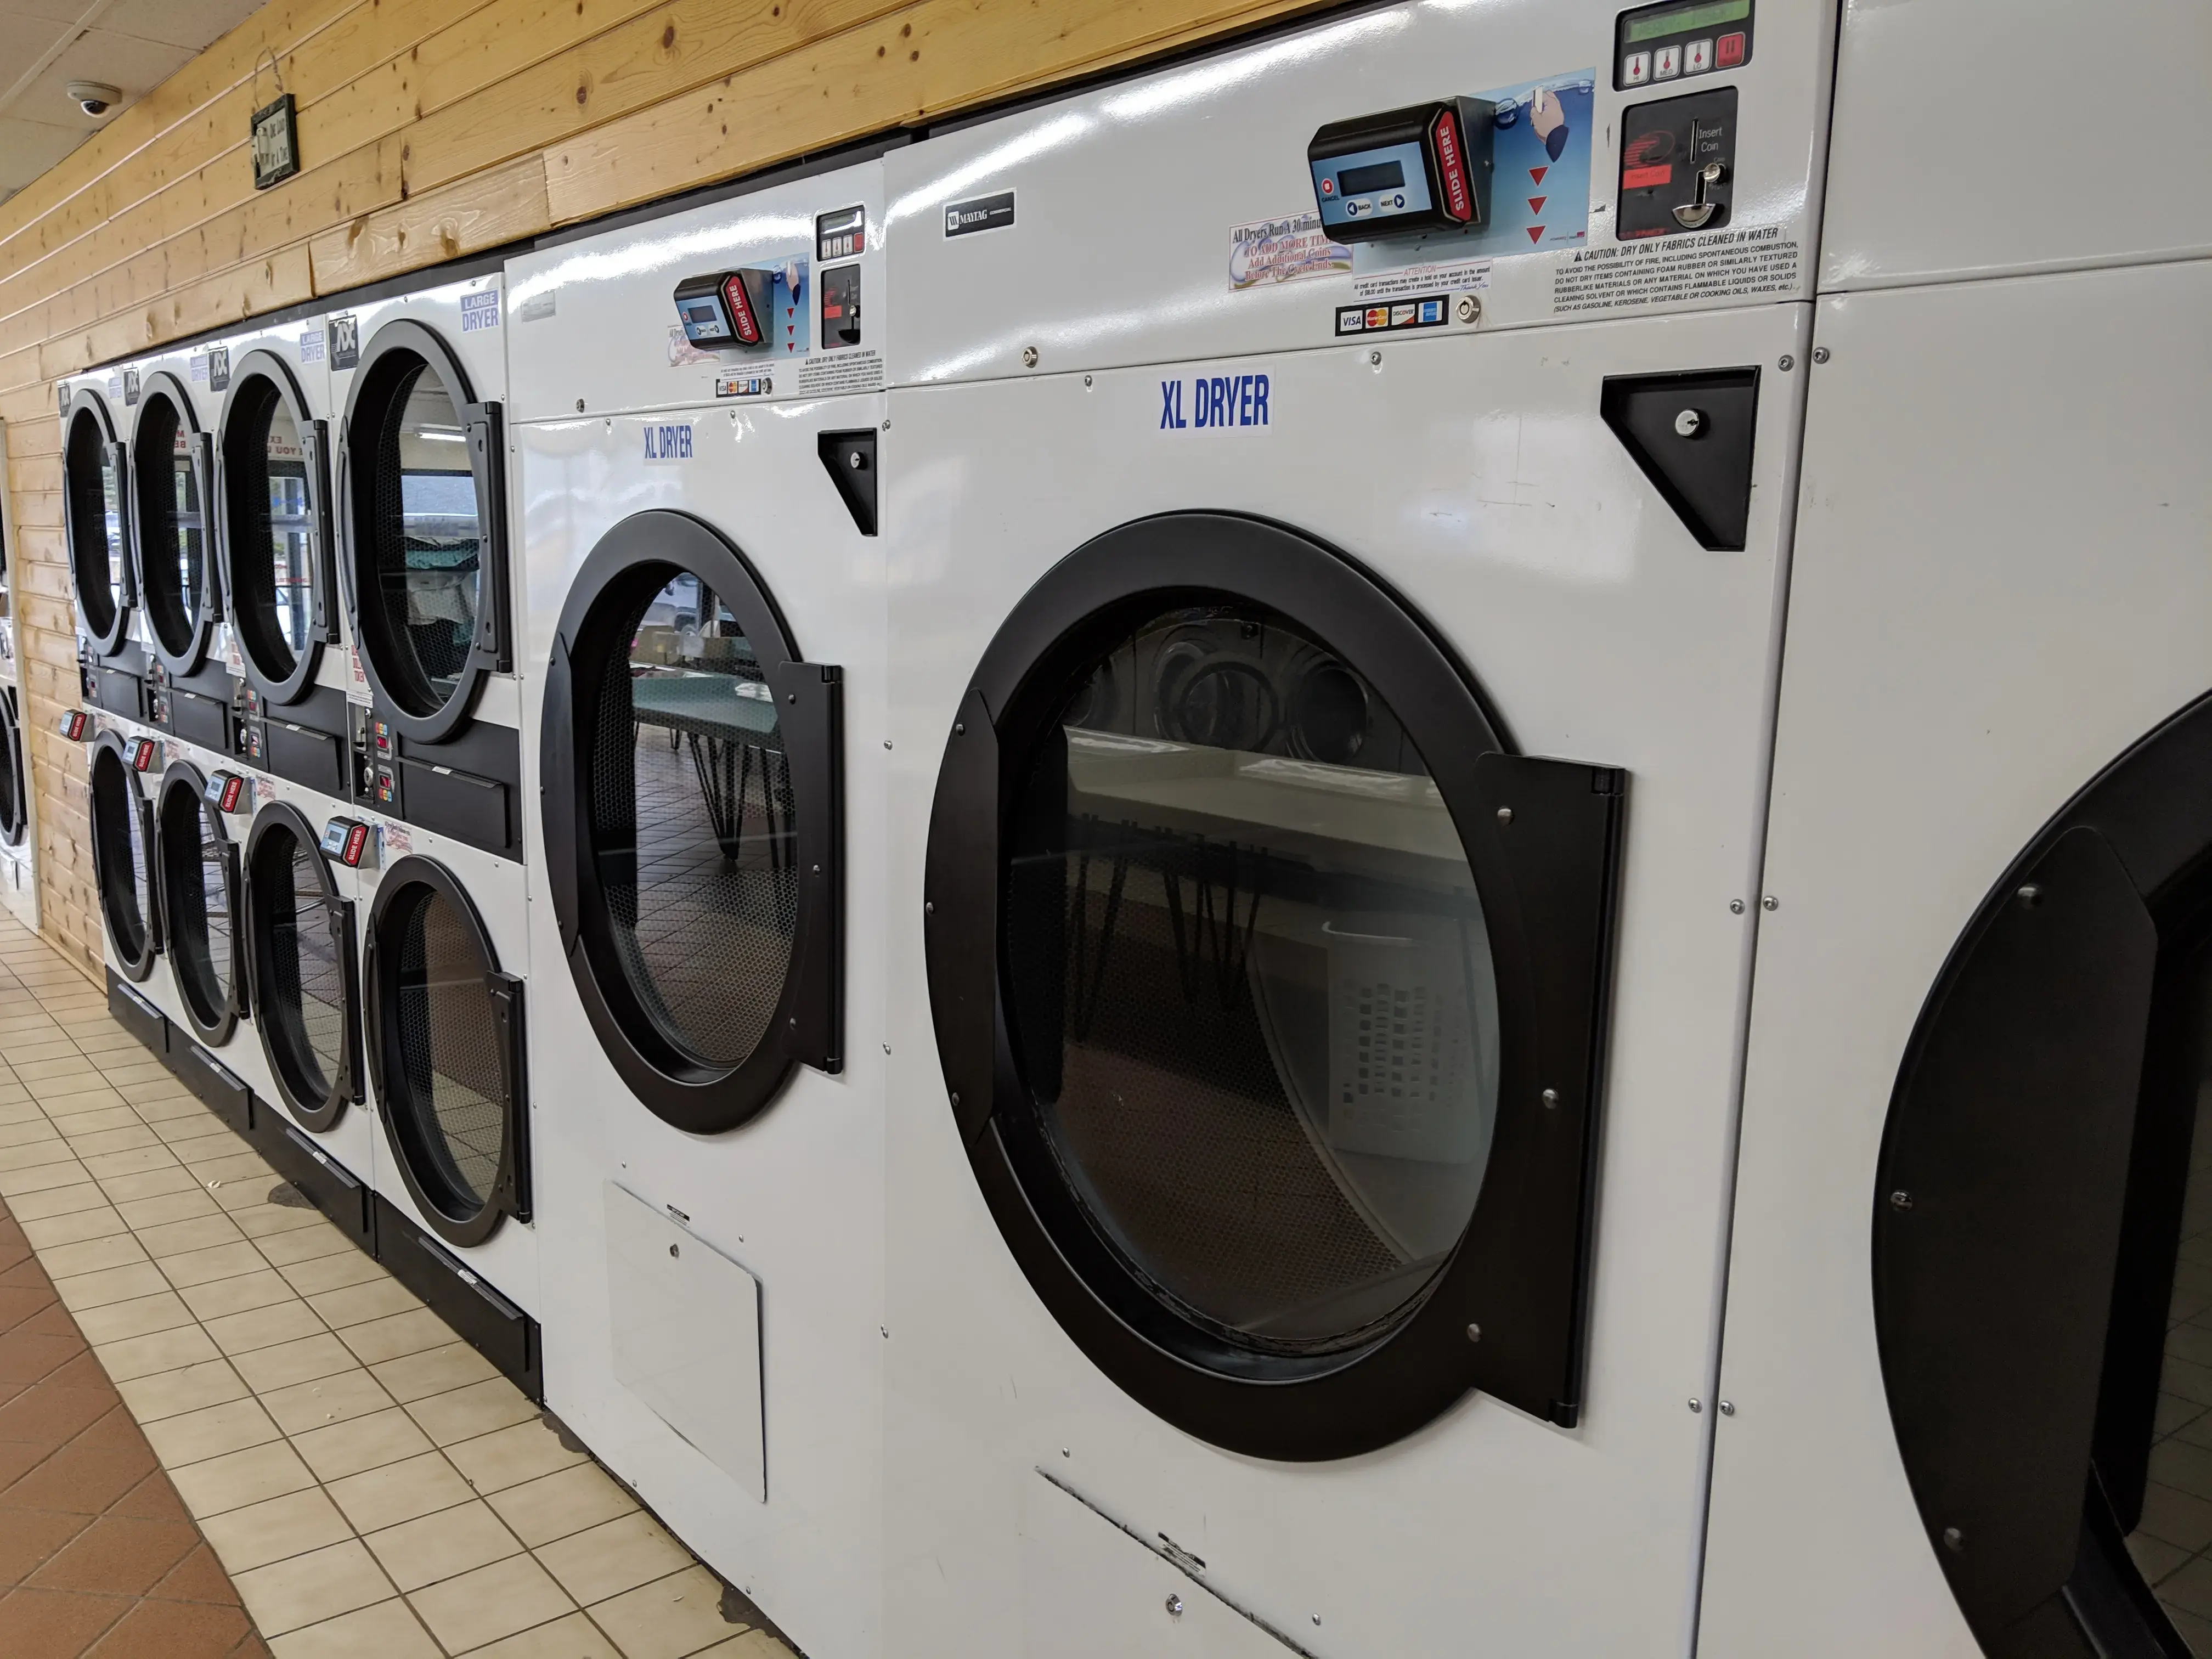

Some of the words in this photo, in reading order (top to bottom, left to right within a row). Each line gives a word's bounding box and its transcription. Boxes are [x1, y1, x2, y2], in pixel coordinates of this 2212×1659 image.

[1699, 126, 1723, 139] Insert
[1440, 126, 1455, 167] HERE
[1701, 142, 1719, 153] Coin
[1449, 168, 1464, 211] SLIDE
[959, 209, 988, 224] MAYTAG
[1233, 227, 1243, 243] All
[1244, 226, 1268, 244] Dryers
[1269, 223, 1283, 236] Run
[1284, 221, 1291, 234] A
[1293, 218, 1301, 233] 30
[1244, 246, 1257, 258] TO
[1258, 242, 1278, 255] ADD
[1280, 238, 1308, 252] MORE
[1584, 248, 1619, 261] CAUTION:
[1621, 245, 1638, 257] DRY
[1639, 242, 1661, 255] ONLY
[1661, 237, 1696, 251] FABRICS
[1697, 233, 1735, 247] CLEANED
[1736, 232, 1746, 242] IN
[1748, 228, 1778, 241] WATER
[1248, 257, 1264, 269] Add
[1266, 250, 1306, 265] Additional
[1308, 246, 1331, 258] Coins
[1565, 266, 1583, 274] AVOID
[1597, 261, 1634, 270] POSSIBILITY
[1662, 253, 1697, 263] INCLUDING
[1699, 247, 1749, 259] SPONTANEOUS
[1750, 241, 1798, 253] COMBUSTION,
[1594, 272, 1613, 280] ITEMS
[1615, 268, 1655, 278] CONTAINING
[1657, 265, 1675, 273] FOAM
[1677, 262, 1706, 270] RUBBER
[1720, 256, 1757, 267] SIMILARLY
[1760, 251, 1798, 262] TEXTURED
[1245, 269, 1270, 281] Before
[1272, 266, 1286, 277] The
[1404, 265, 1437, 276] ATTENTION
[1554, 284, 1593, 294] RUBBERLIKE
[1595, 280, 1631, 289] MATERIALS
[1659, 273, 1692, 283] MATERIAL
[1707, 269, 1730, 278] WHICH
[1748, 265, 1768, 273] HAVE
[1770, 262, 1790, 271] USED
[729, 285, 743, 309] HERE
[1554, 294, 1584, 303] CLEANING
[1586, 291, 1615, 300] SOLVENT
[1650, 284, 1683, 294] CONTAINS
[1684, 279, 1726, 290] FLAMMABLE
[1728, 276, 1756, 285] LIQUIDS
[1770, 272, 1797, 281] SOLIDS
[1554, 304, 1572, 314] (SUCH
[1582, 301, 1613, 309] GASOLINE,
[1651, 293, 1688, 303] VEGETABLE
[1700, 289, 1731, 298] COOKING
[1732, 287, 1749, 295] OILS,
[1751, 284, 1777, 293] WAXES,
[464, 292, 495, 309] LARGE
[462, 307, 499, 332] DRYER
[738, 310, 752, 336] SLIDE
[1343, 316, 1361, 326] VISA
[301, 331, 323, 345] LARGE
[337, 323, 356, 352] ADC
[213, 352, 228, 377] ADC
[301, 343, 325, 363] DRYER
[1160, 380, 1187, 429] XL
[1194, 374, 1269, 428] DRYER
[644, 427, 657, 459] XL
[659, 425, 693, 459] DRYER
[352, 830, 362, 844] HERE
[348, 845, 358, 860] SLIDE
